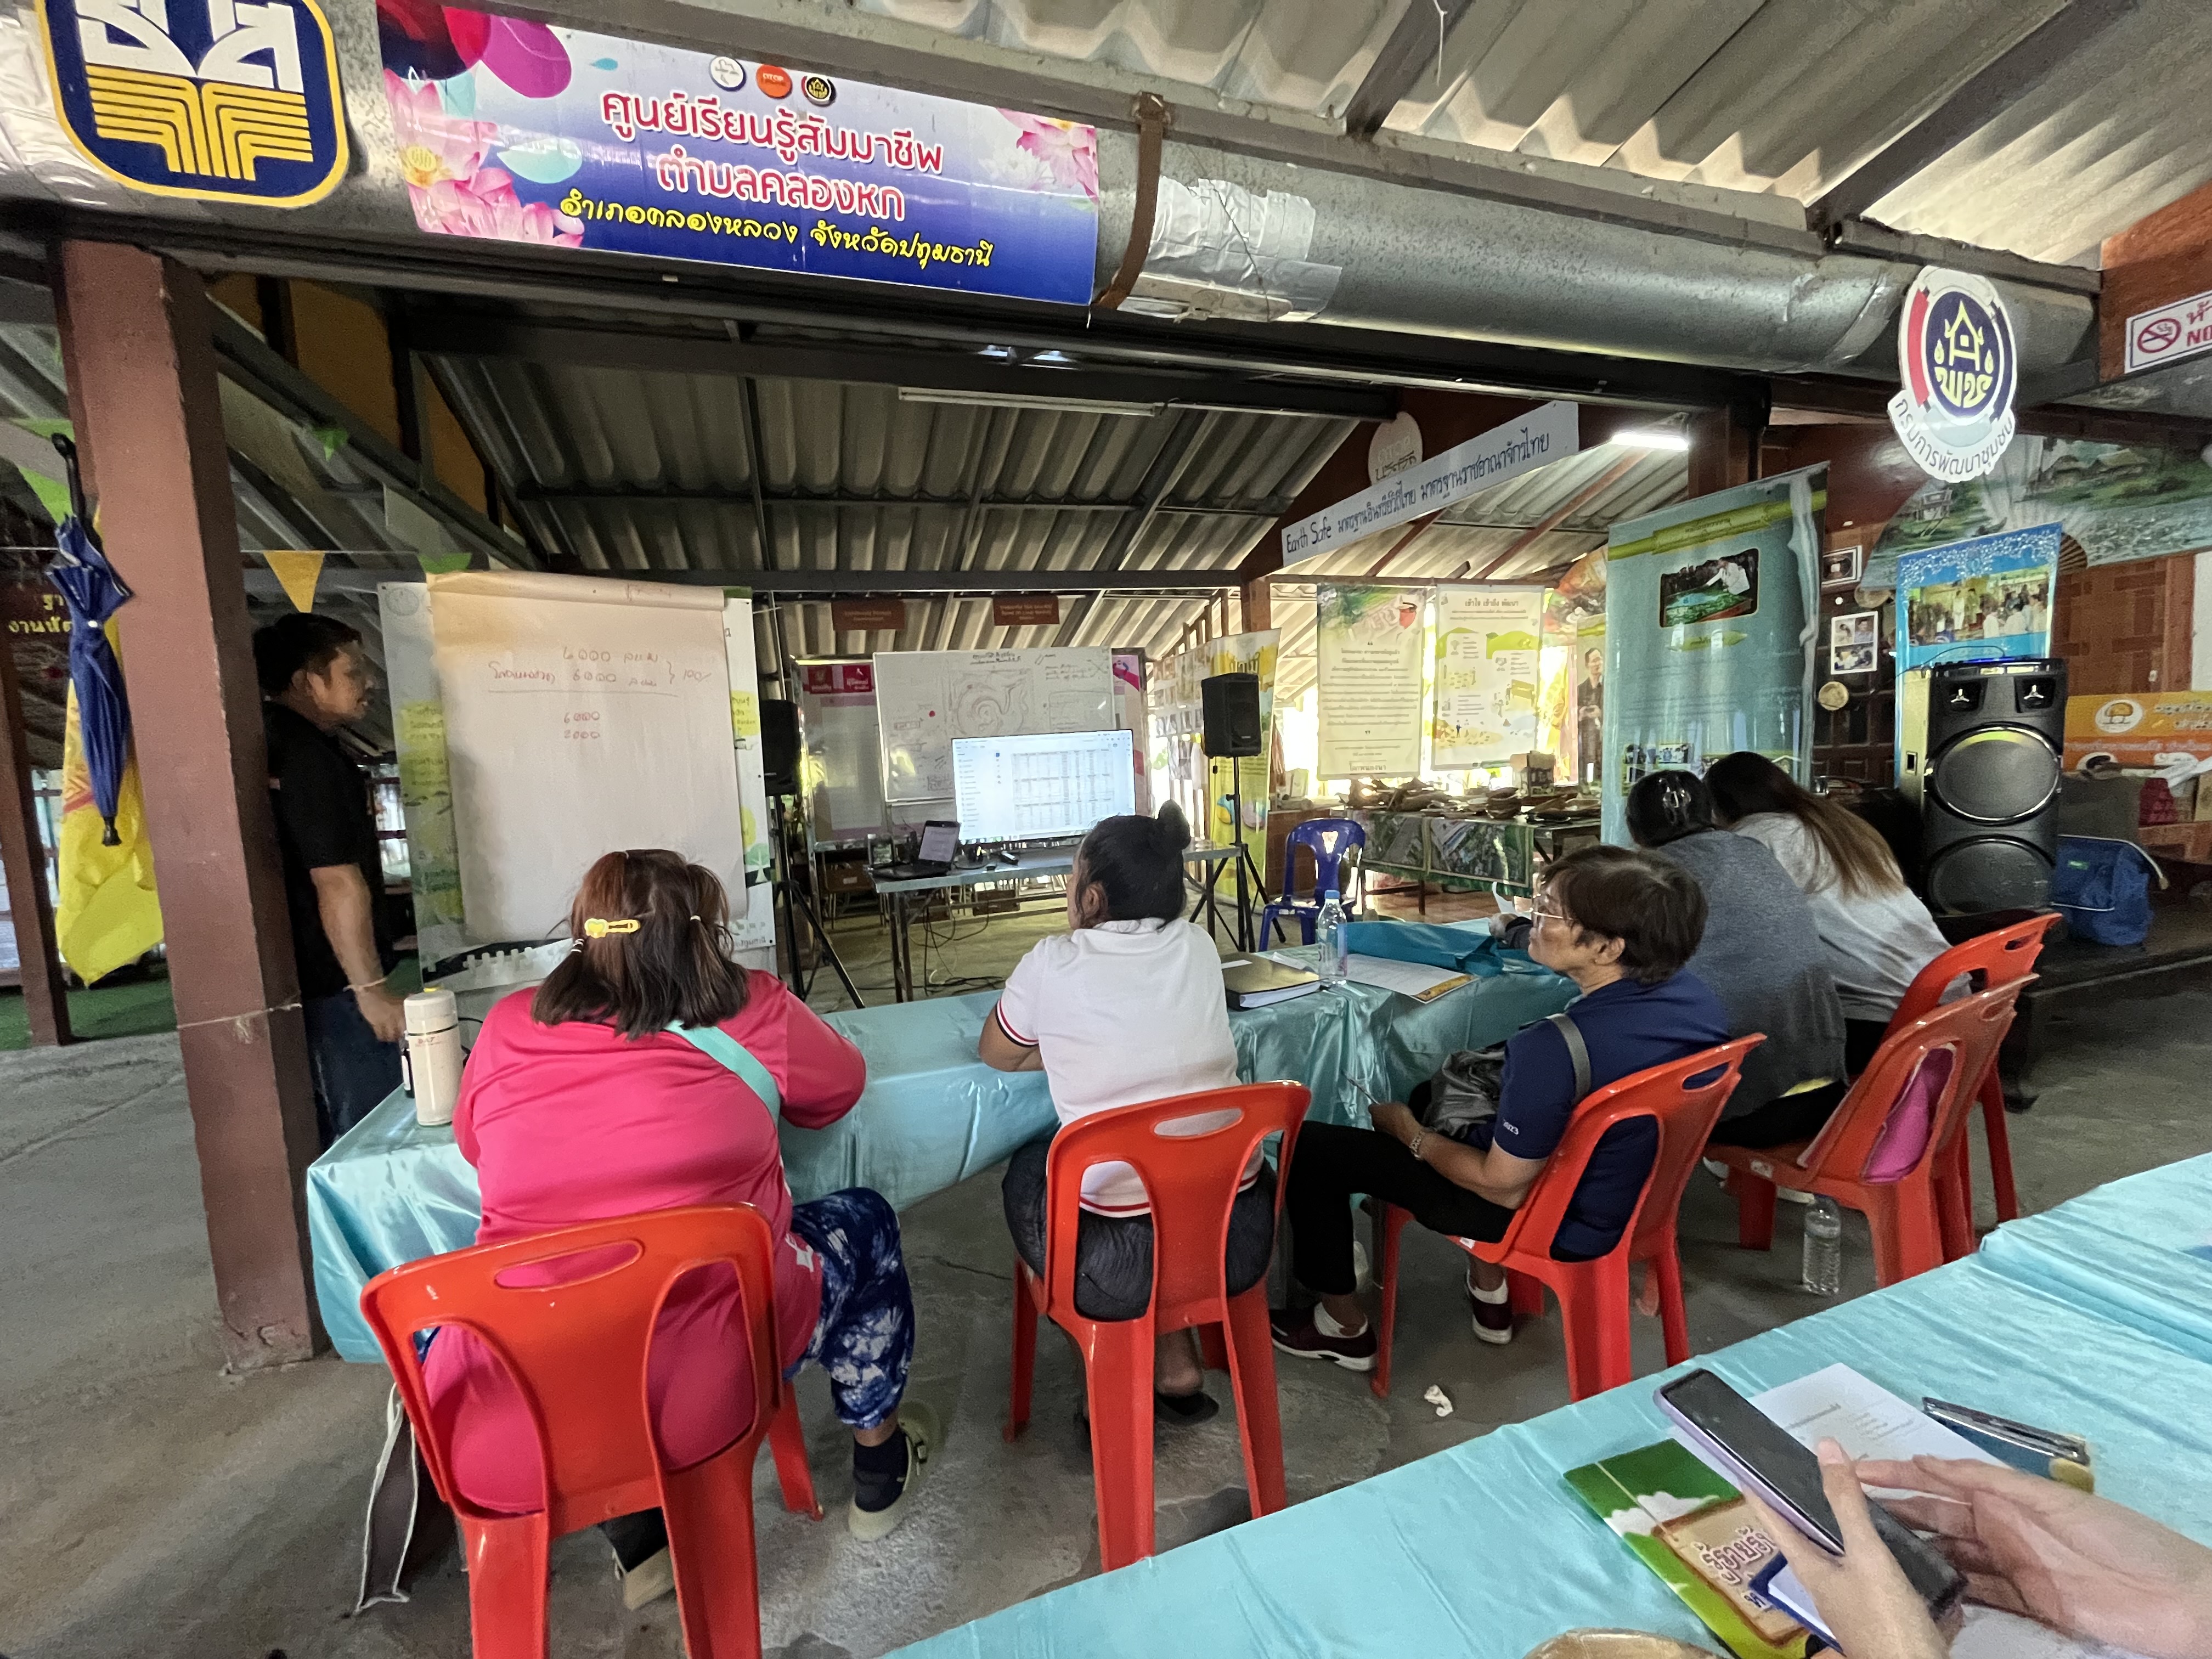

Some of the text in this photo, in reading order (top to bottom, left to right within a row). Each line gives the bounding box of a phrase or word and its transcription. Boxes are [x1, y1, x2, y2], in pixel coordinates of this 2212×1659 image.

[602, 91, 944, 172] ศูนย์เรียนรู้สัมมาชีพ
[659, 147, 905, 220] ตำบลคลองหก
[560, 188, 994, 269] อำเภอคลองหลวง จังหวัดปทุมธานี
[1894, 398, 2013, 475] กรมการพัฒนาชุมชน
[1286, 527, 1308, 554] Earth
[1311, 517, 1331, 545] Safe
